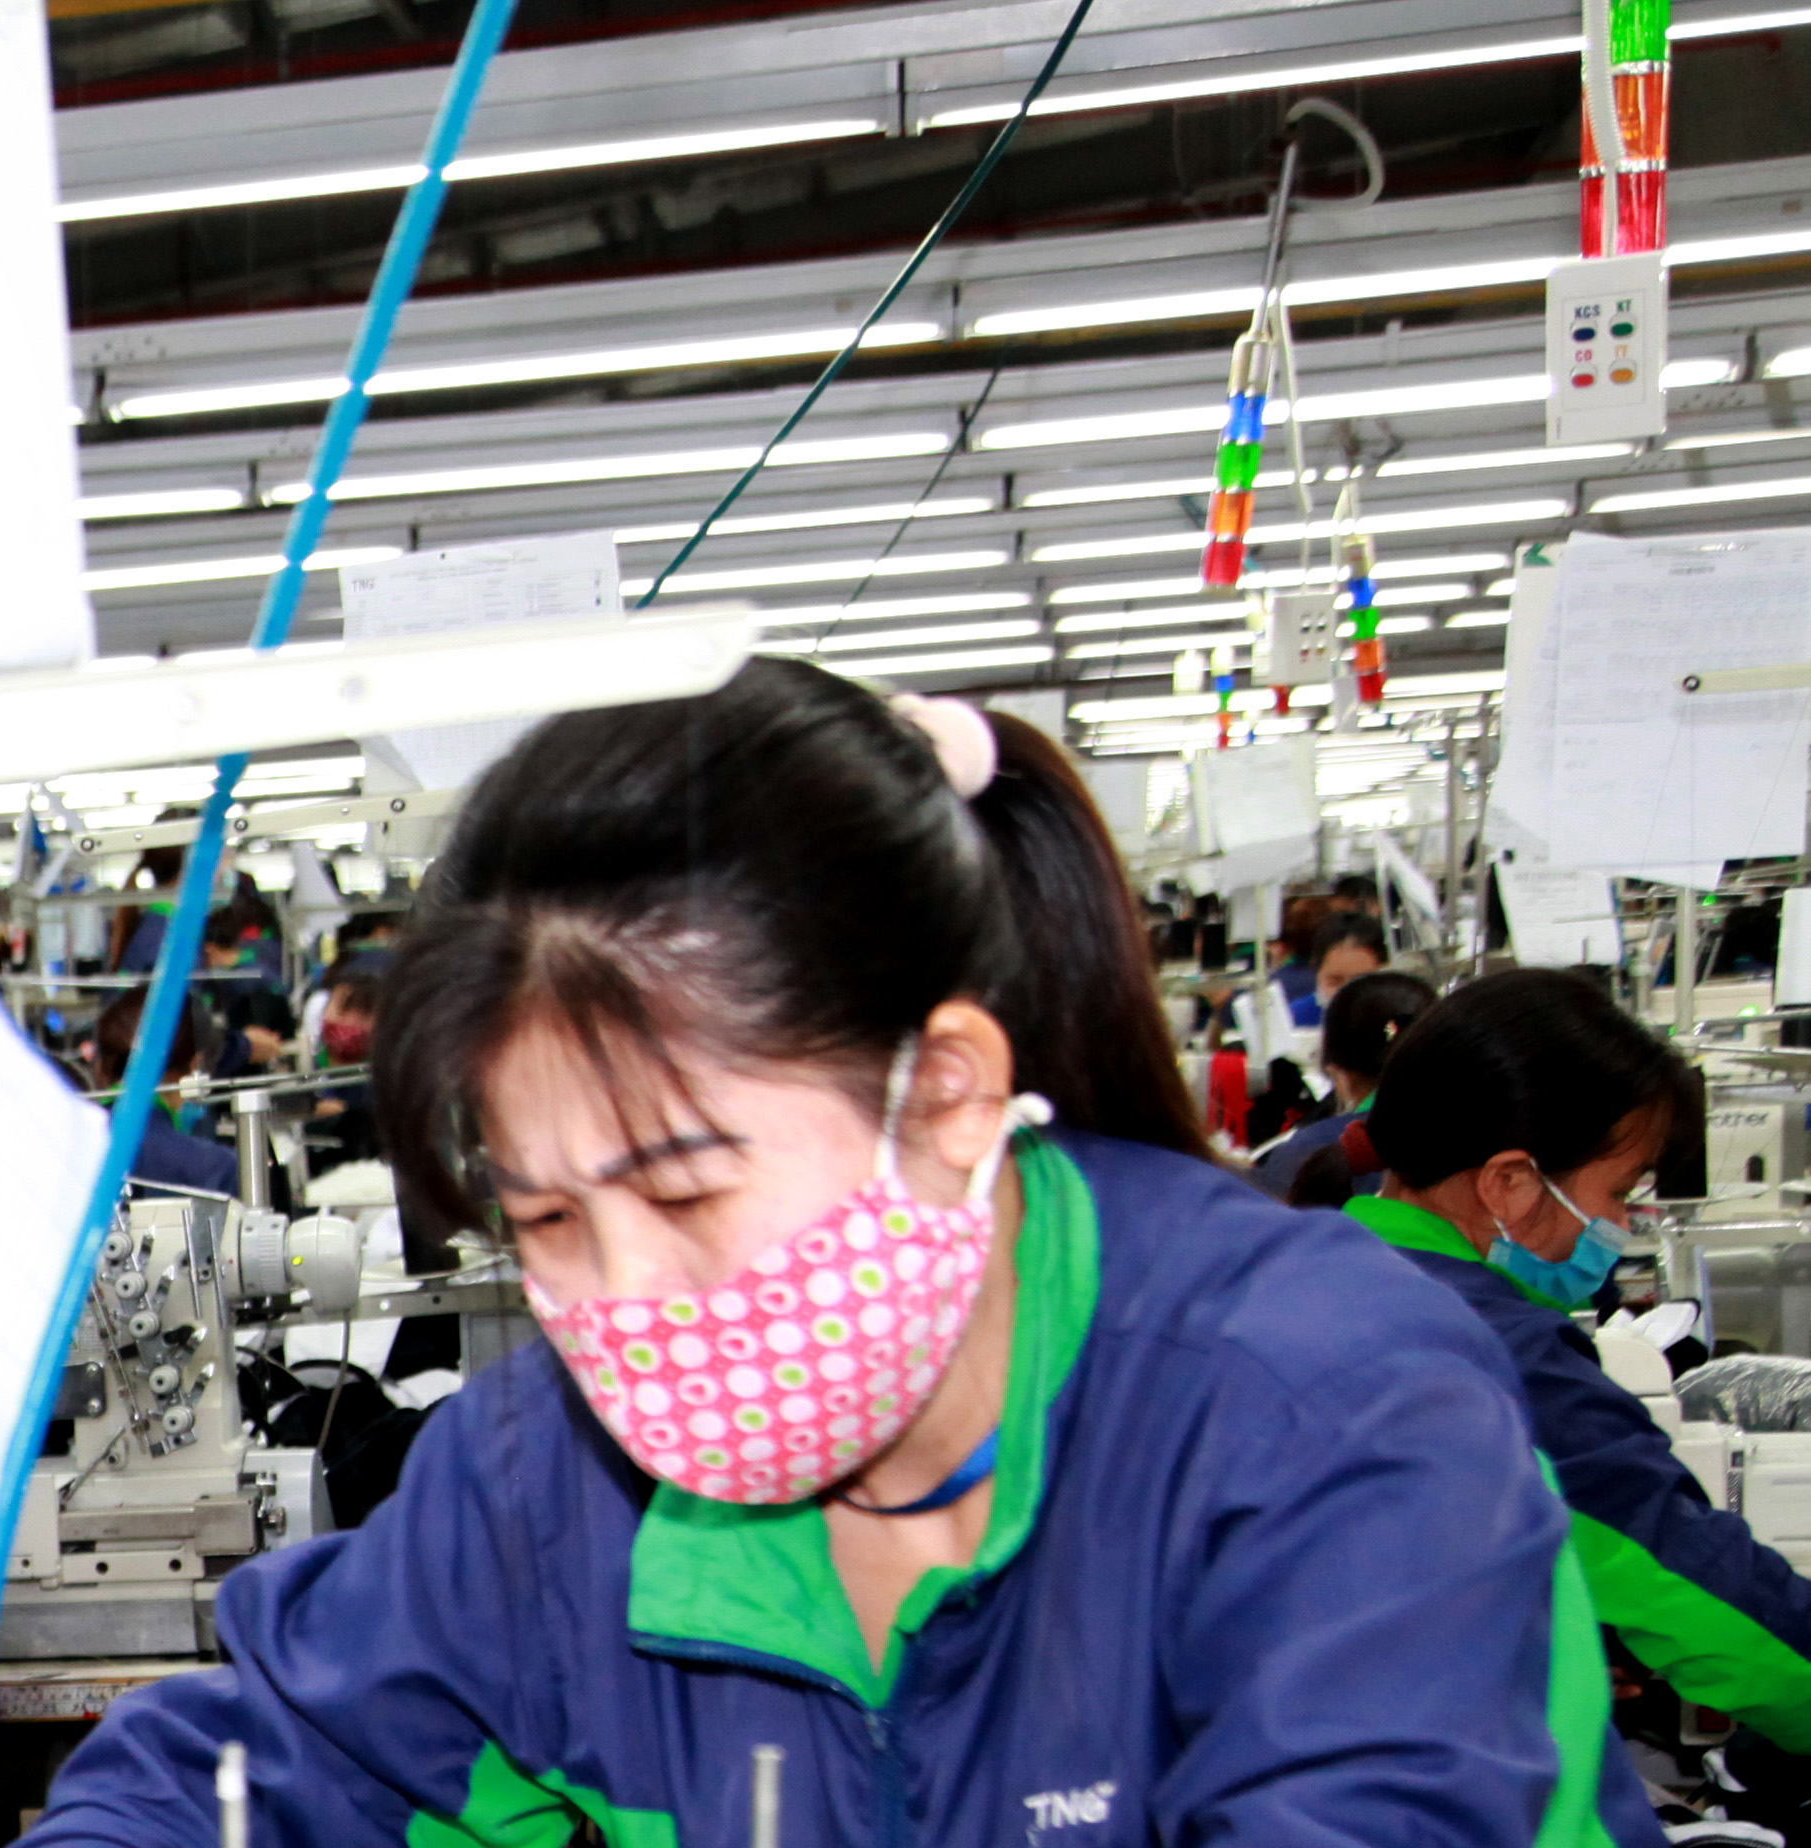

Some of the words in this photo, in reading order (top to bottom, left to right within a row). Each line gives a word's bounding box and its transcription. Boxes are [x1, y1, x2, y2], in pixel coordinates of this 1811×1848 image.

[1574, 305, 1600, 317] KCS
[1616, 301, 1632, 312] KT
[1022, 1780, 1117, 1830] TNG
